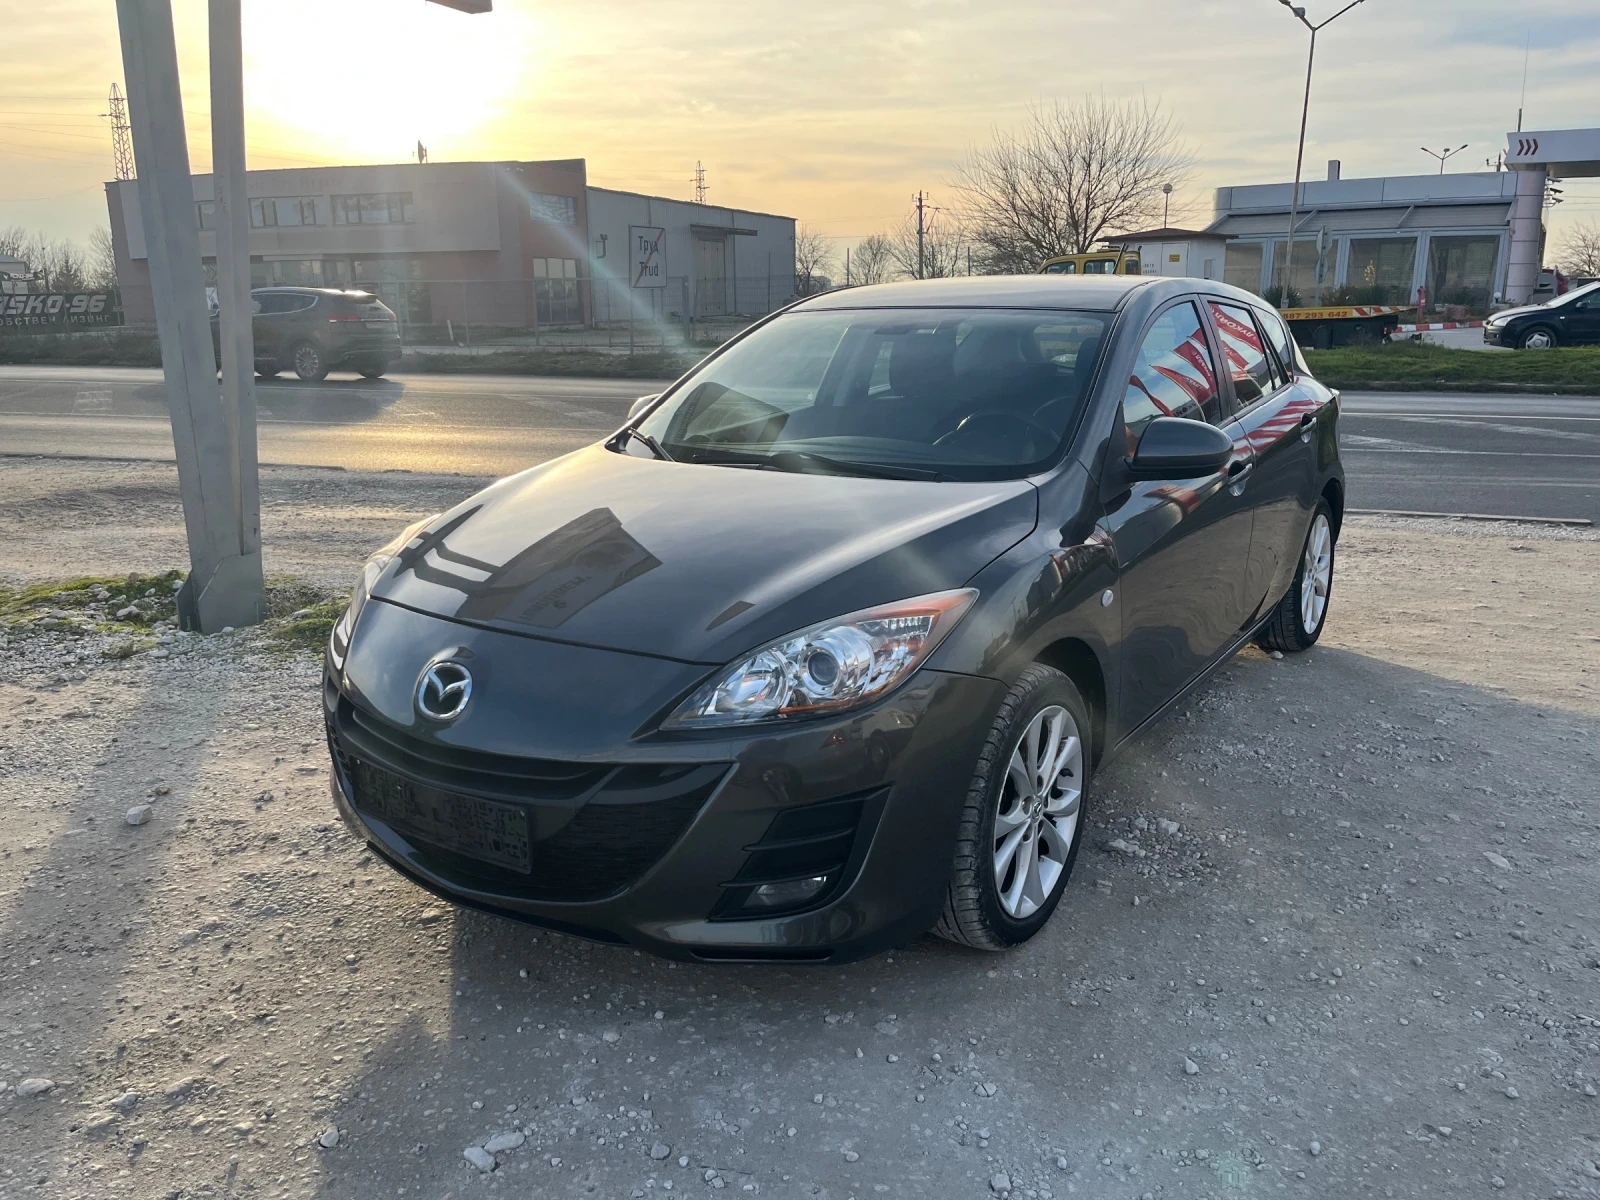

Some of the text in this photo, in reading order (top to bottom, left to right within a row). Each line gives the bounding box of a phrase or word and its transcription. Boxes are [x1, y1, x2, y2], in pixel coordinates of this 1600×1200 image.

[638, 236, 658, 255] Труд
[639, 262, 658, 276] Trud
[1304, 311, 1324, 319] 293
